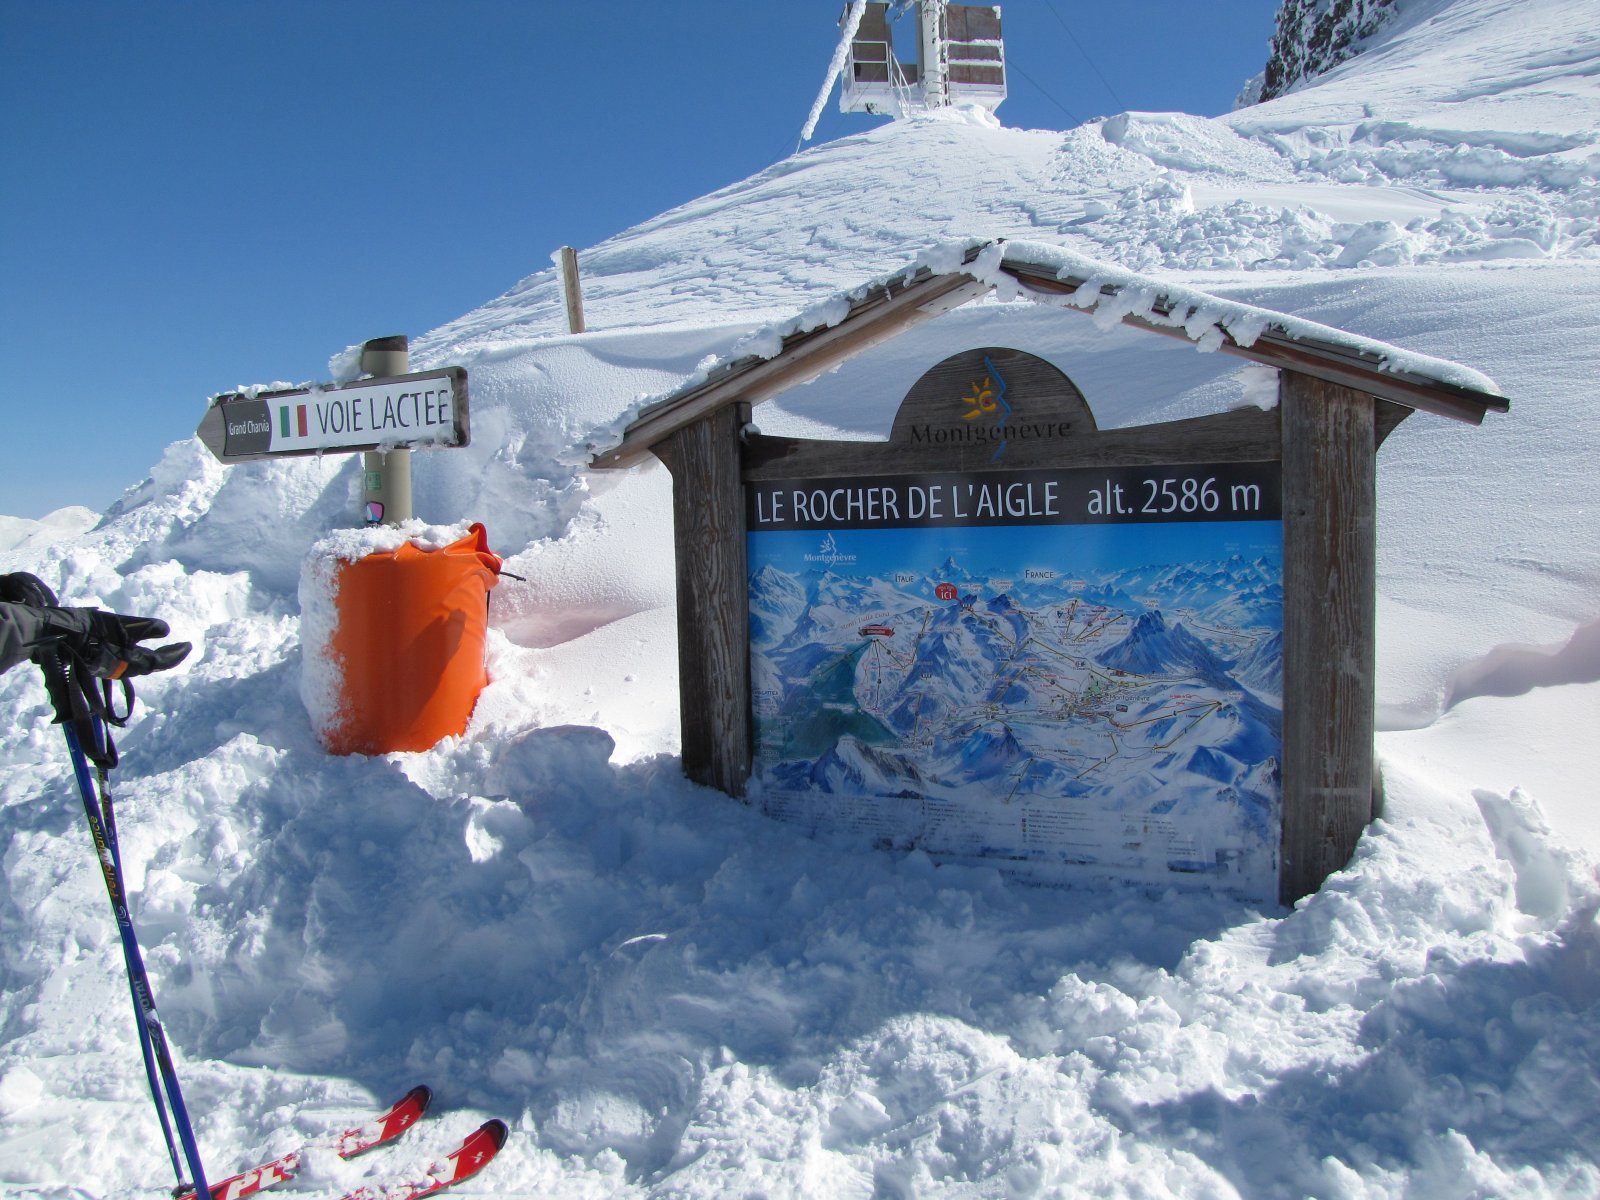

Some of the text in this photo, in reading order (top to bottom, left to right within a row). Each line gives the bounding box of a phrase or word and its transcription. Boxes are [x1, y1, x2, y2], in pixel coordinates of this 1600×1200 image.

[229, 419, 270, 435] Grand Charvia
[316, 398, 363, 434] VOIE
[757, 477, 1260, 522] LE ROCHER DE L'AIGLE alt. 2586 m
